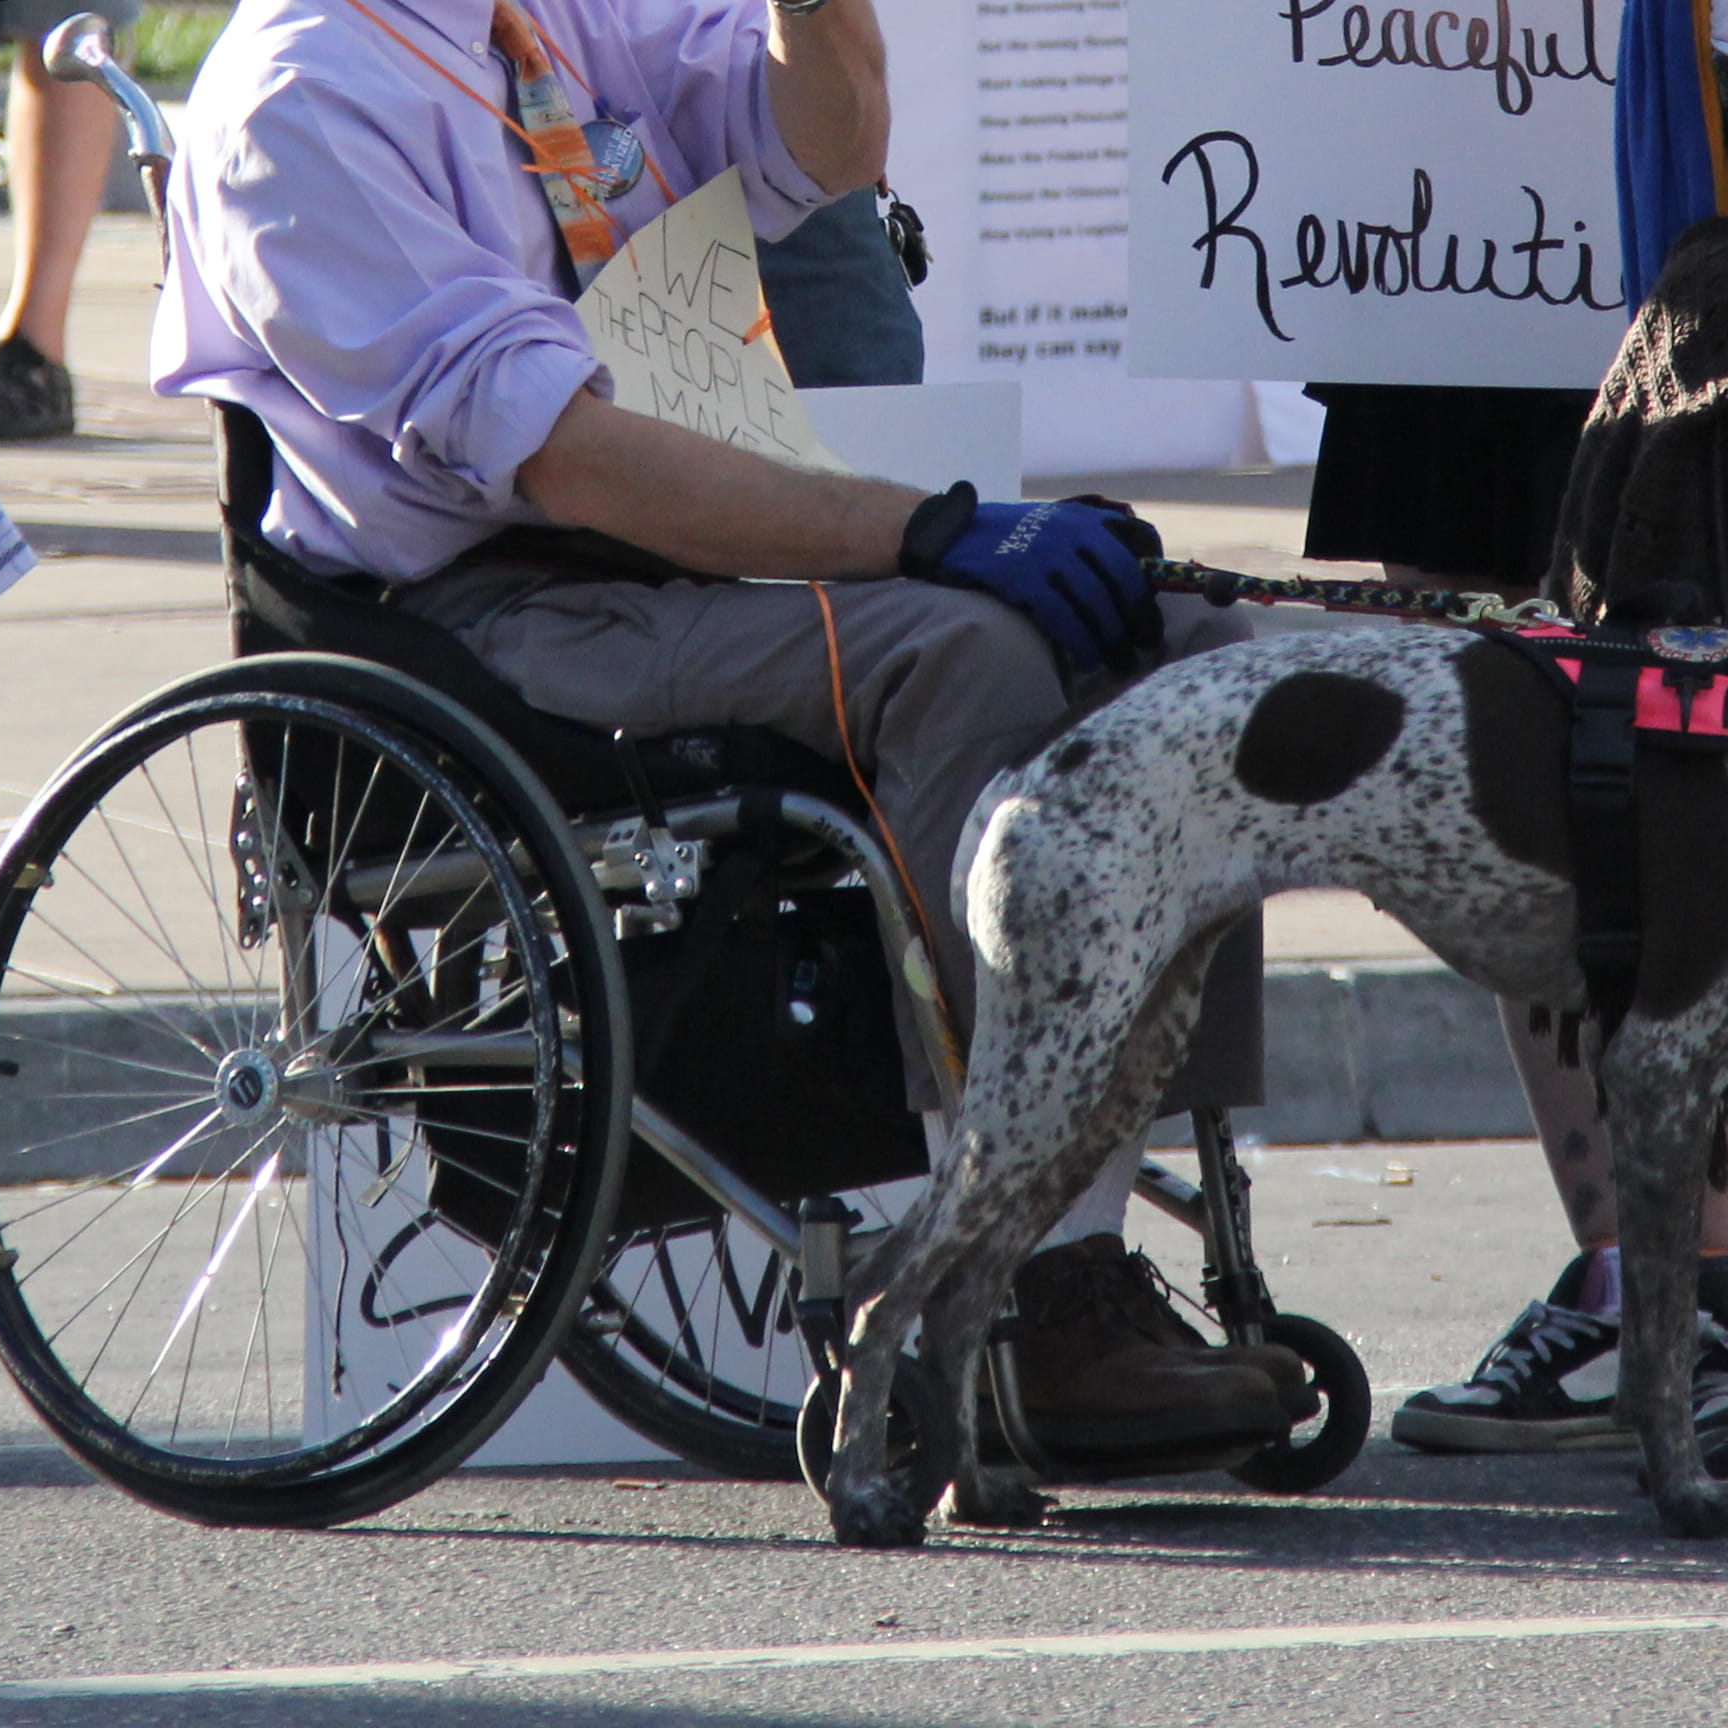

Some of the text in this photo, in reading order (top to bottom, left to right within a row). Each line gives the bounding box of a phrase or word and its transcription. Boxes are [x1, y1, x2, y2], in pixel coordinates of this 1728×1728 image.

[663, 213, 752, 344] WE
[1162, 130, 1627, 342] Revoluti
[592, 285, 801, 457] THE PEOPLE
[978, 305, 1018, 330] But
[1025, 304, 1041, 328] if
[1047, 303, 1063, 328] it
[978, 336, 1122, 364] they can say
